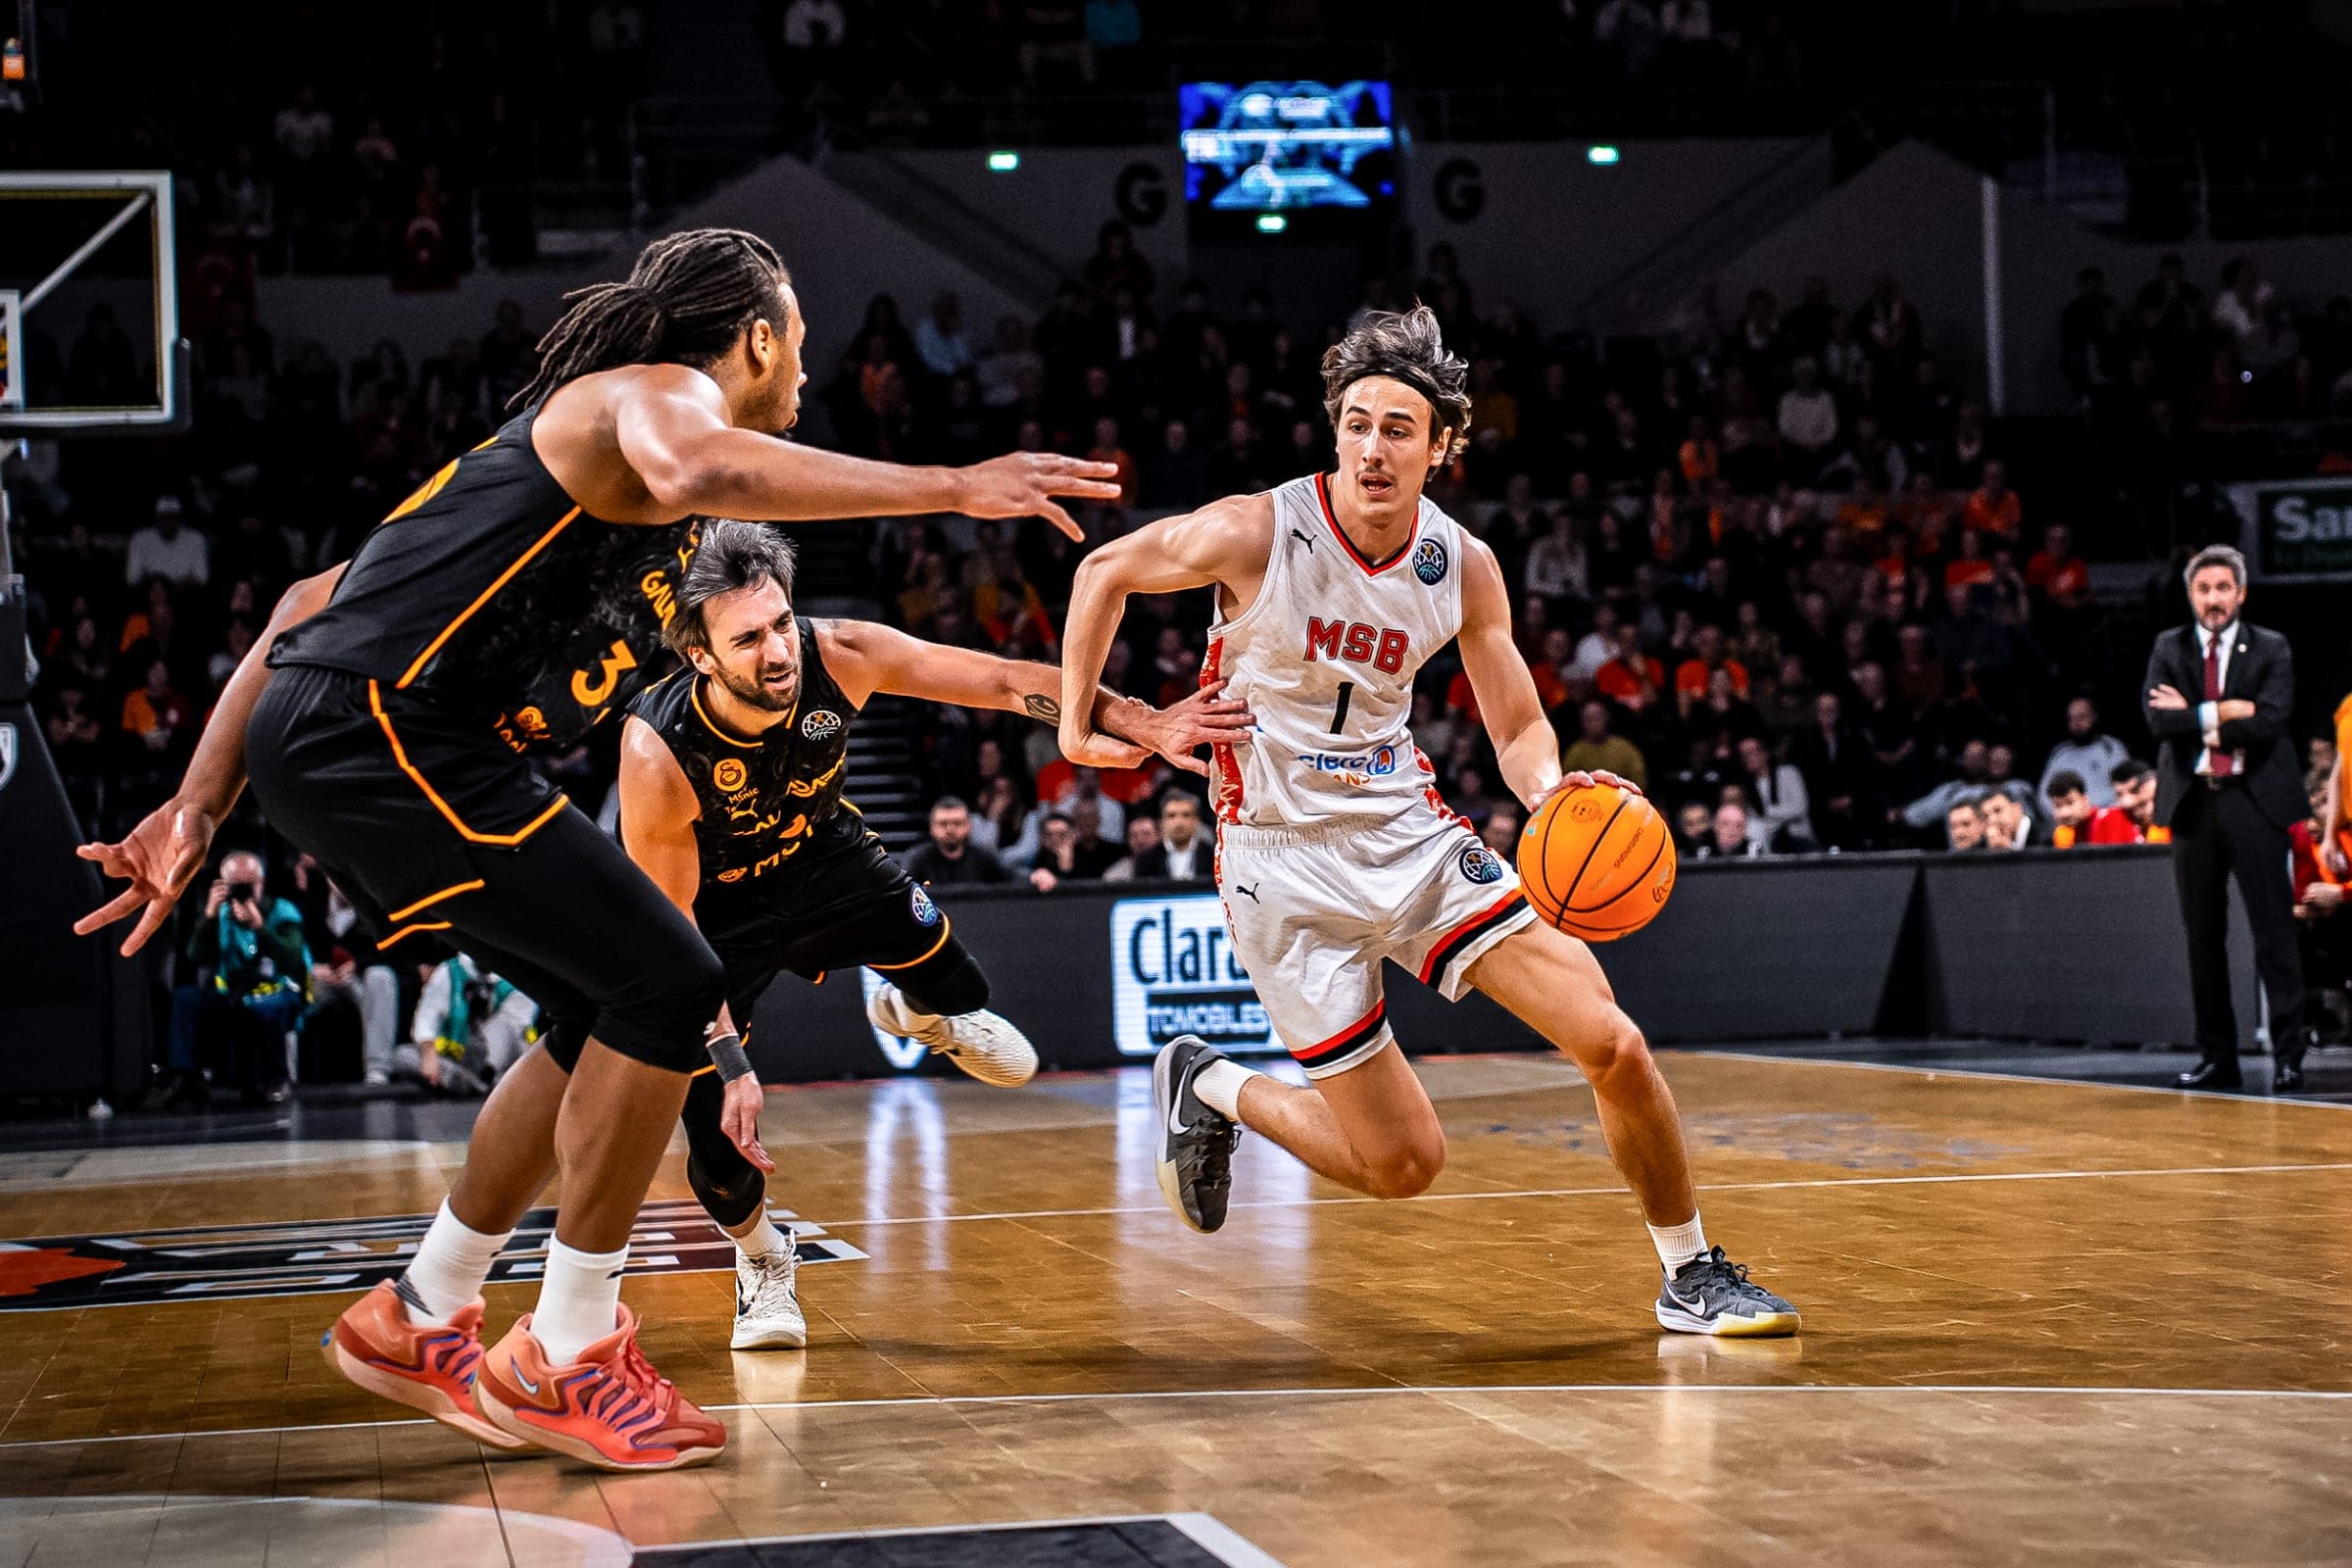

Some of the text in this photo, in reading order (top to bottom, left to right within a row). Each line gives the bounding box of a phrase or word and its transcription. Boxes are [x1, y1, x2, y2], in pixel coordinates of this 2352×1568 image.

[1115, 163, 1168, 225] G
[1434, 159, 1483, 222] G
[571, 639, 637, 707] 3
[1303, 616, 1409, 675] MSB
[1331, 681, 1354, 735] 1
